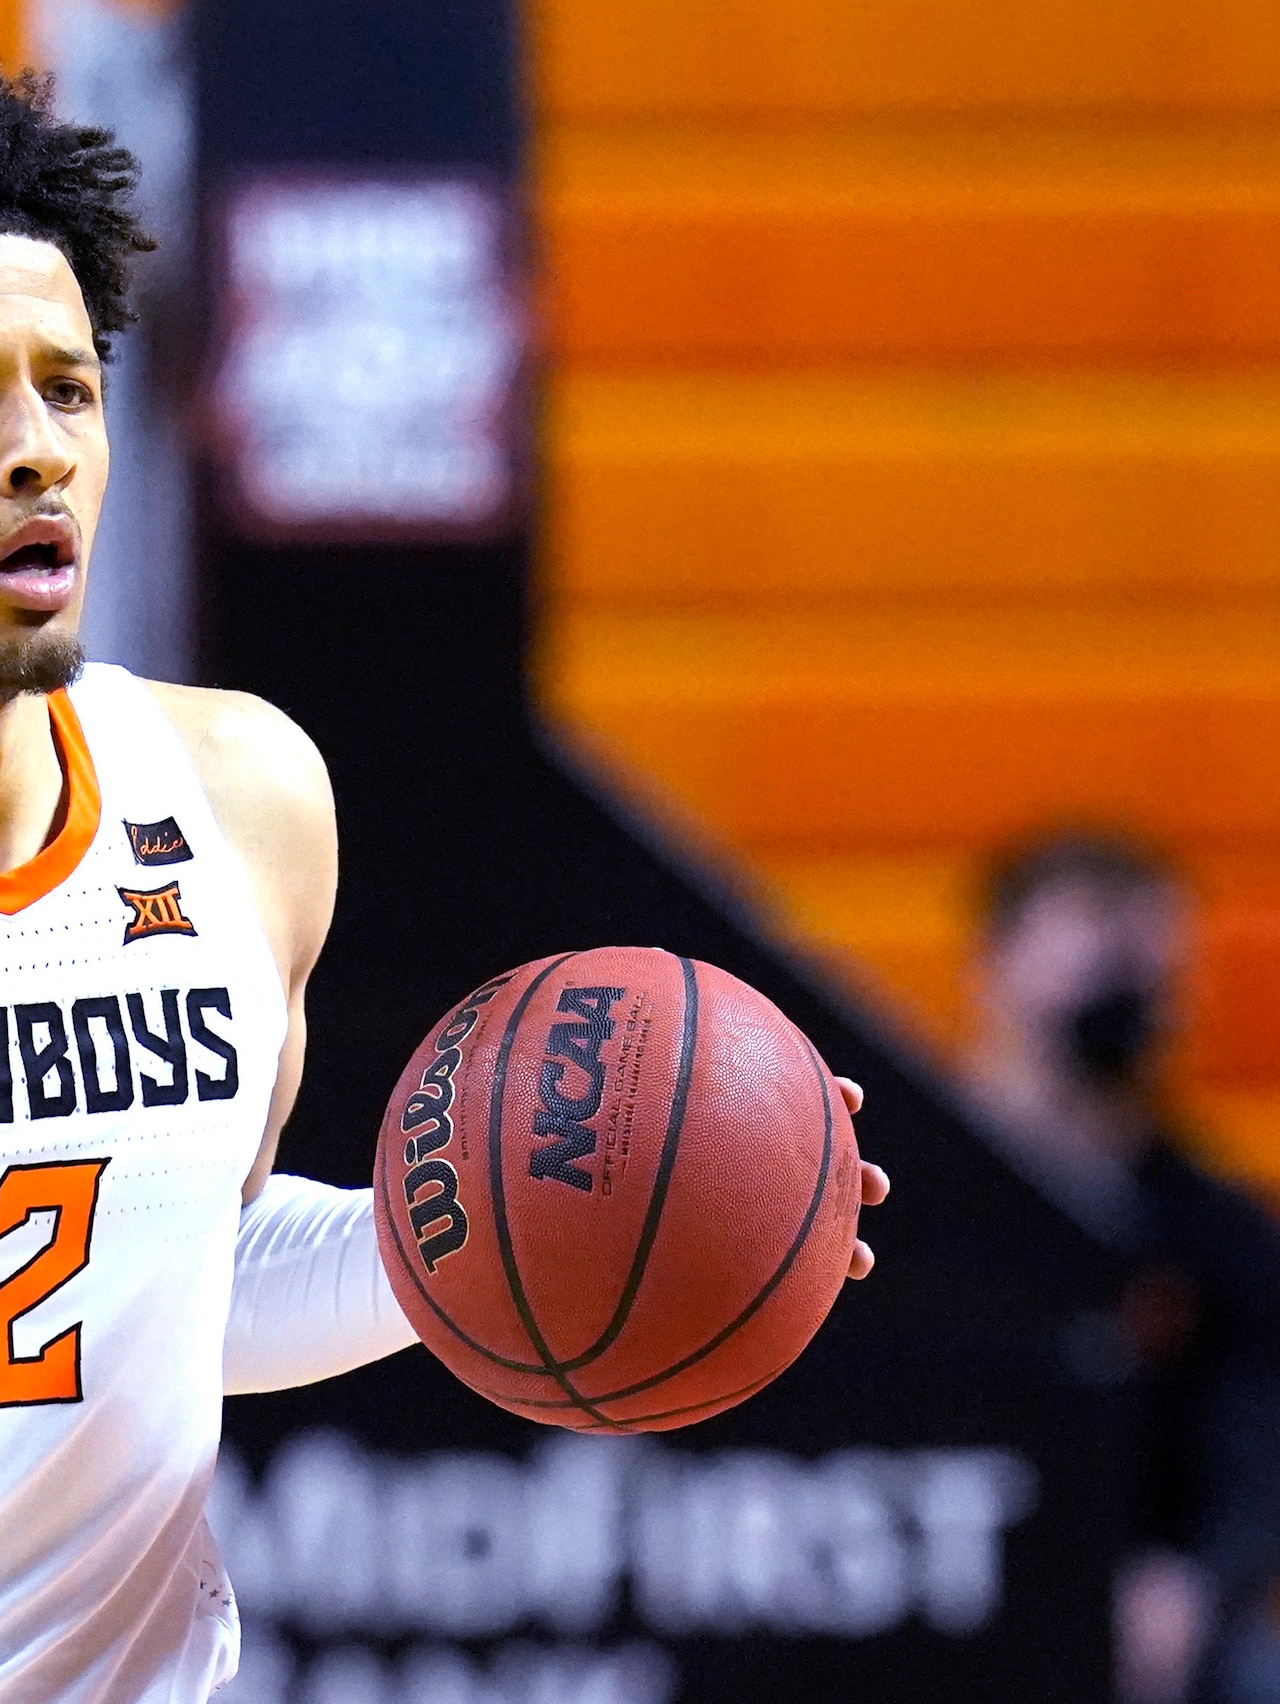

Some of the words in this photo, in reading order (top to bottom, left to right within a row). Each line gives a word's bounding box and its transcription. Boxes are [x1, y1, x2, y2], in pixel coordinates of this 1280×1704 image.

[121, 885, 194, 936] XII
[400, 972, 519, 1276] Wilson
[530, 986, 626, 1193] NCAA
[602, 1104, 621, 1196] OFFICIAL
[614, 1036, 633, 1091] GAME
